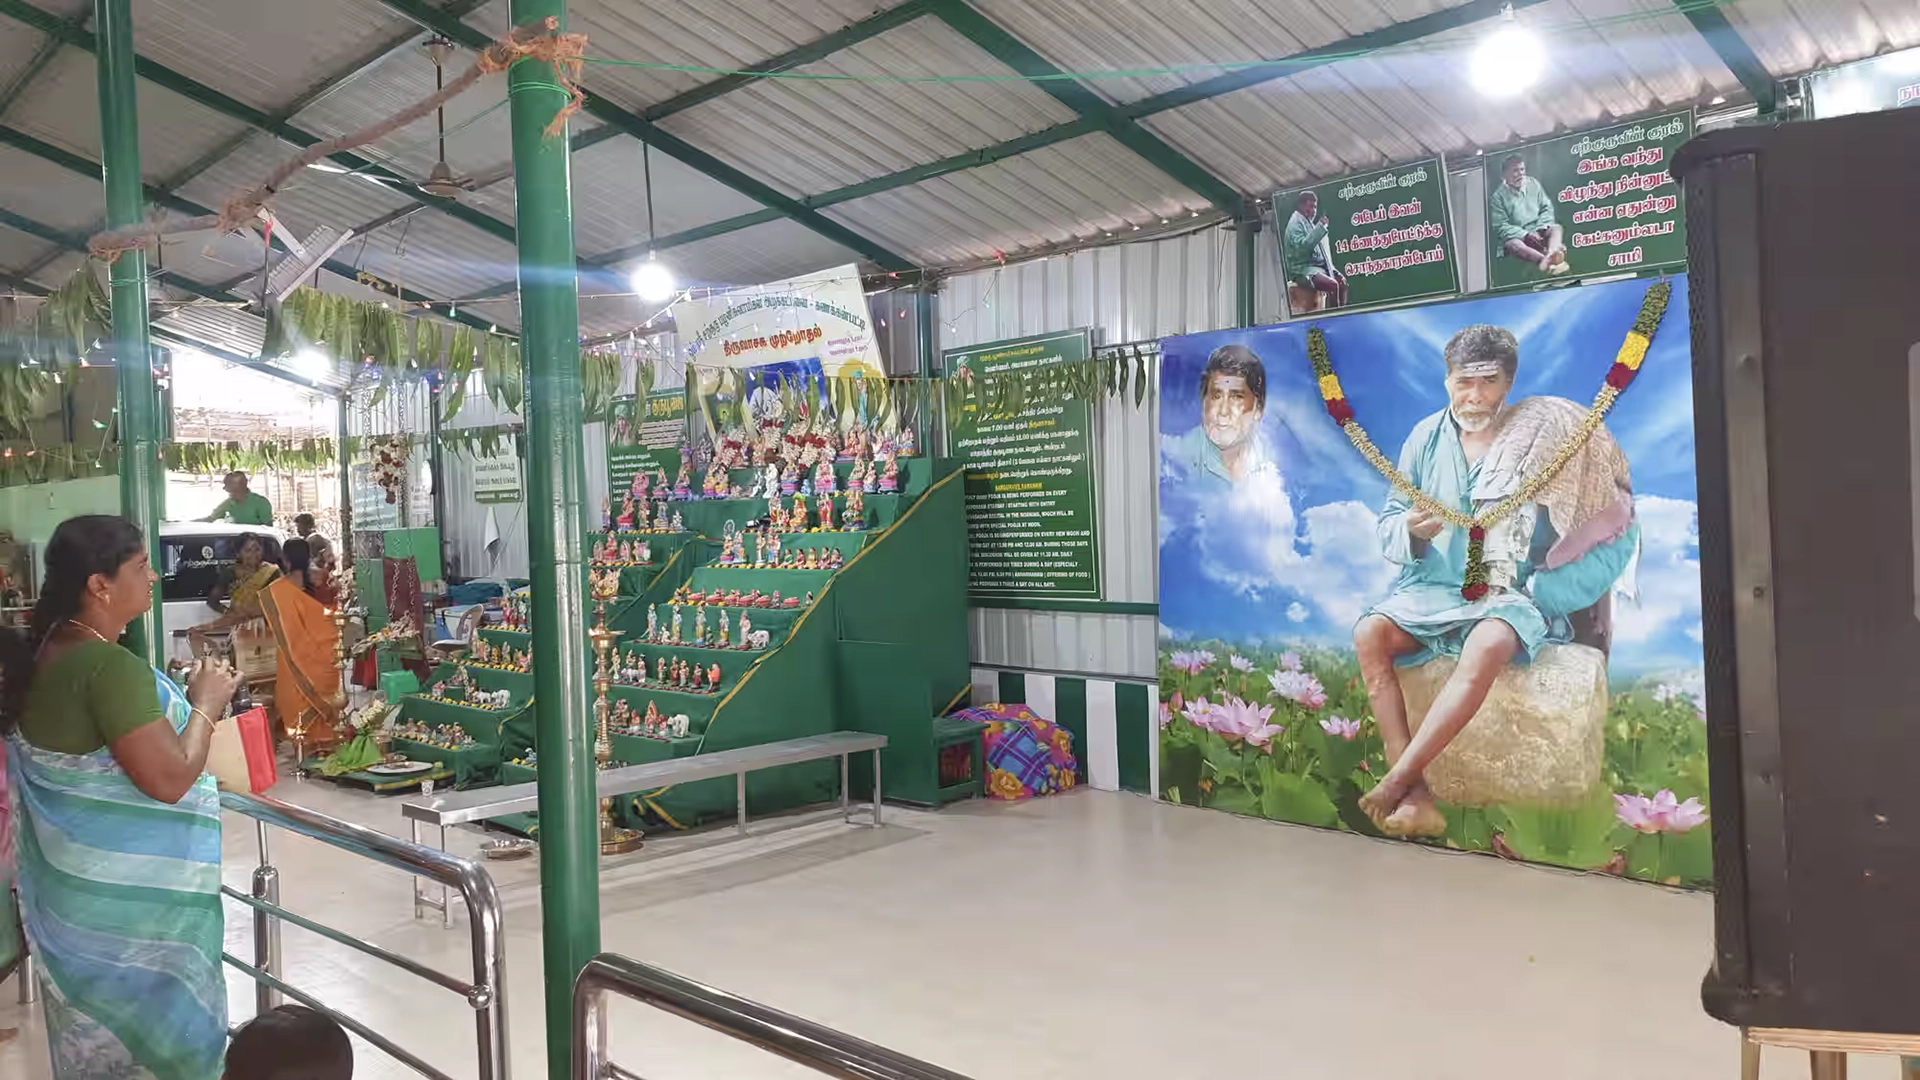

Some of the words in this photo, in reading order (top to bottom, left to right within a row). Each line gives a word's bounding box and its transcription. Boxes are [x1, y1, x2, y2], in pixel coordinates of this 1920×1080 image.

[1570, 126, 1645, 157] சற்குருவின்
[1647, 117, 1684, 140] குரல்
[1577, 154, 1619, 174] இங்க
[1620, 146, 1664, 168] வந்து
[1338, 173, 1397, 201] சற்குருவின்
[1398, 166, 1428, 187] குரல்
[1558, 180, 1613, 203] விழுந்து
[1351, 203, 1387, 226] அடேய்
[1388, 197, 1421, 219] இவன்
[1573, 204, 1613, 224] என்ன
[1335, 239, 1349, 254] 14
[1608, 246, 1643, 266] சாமி
[723, 337, 768, 358] திருவாசக
